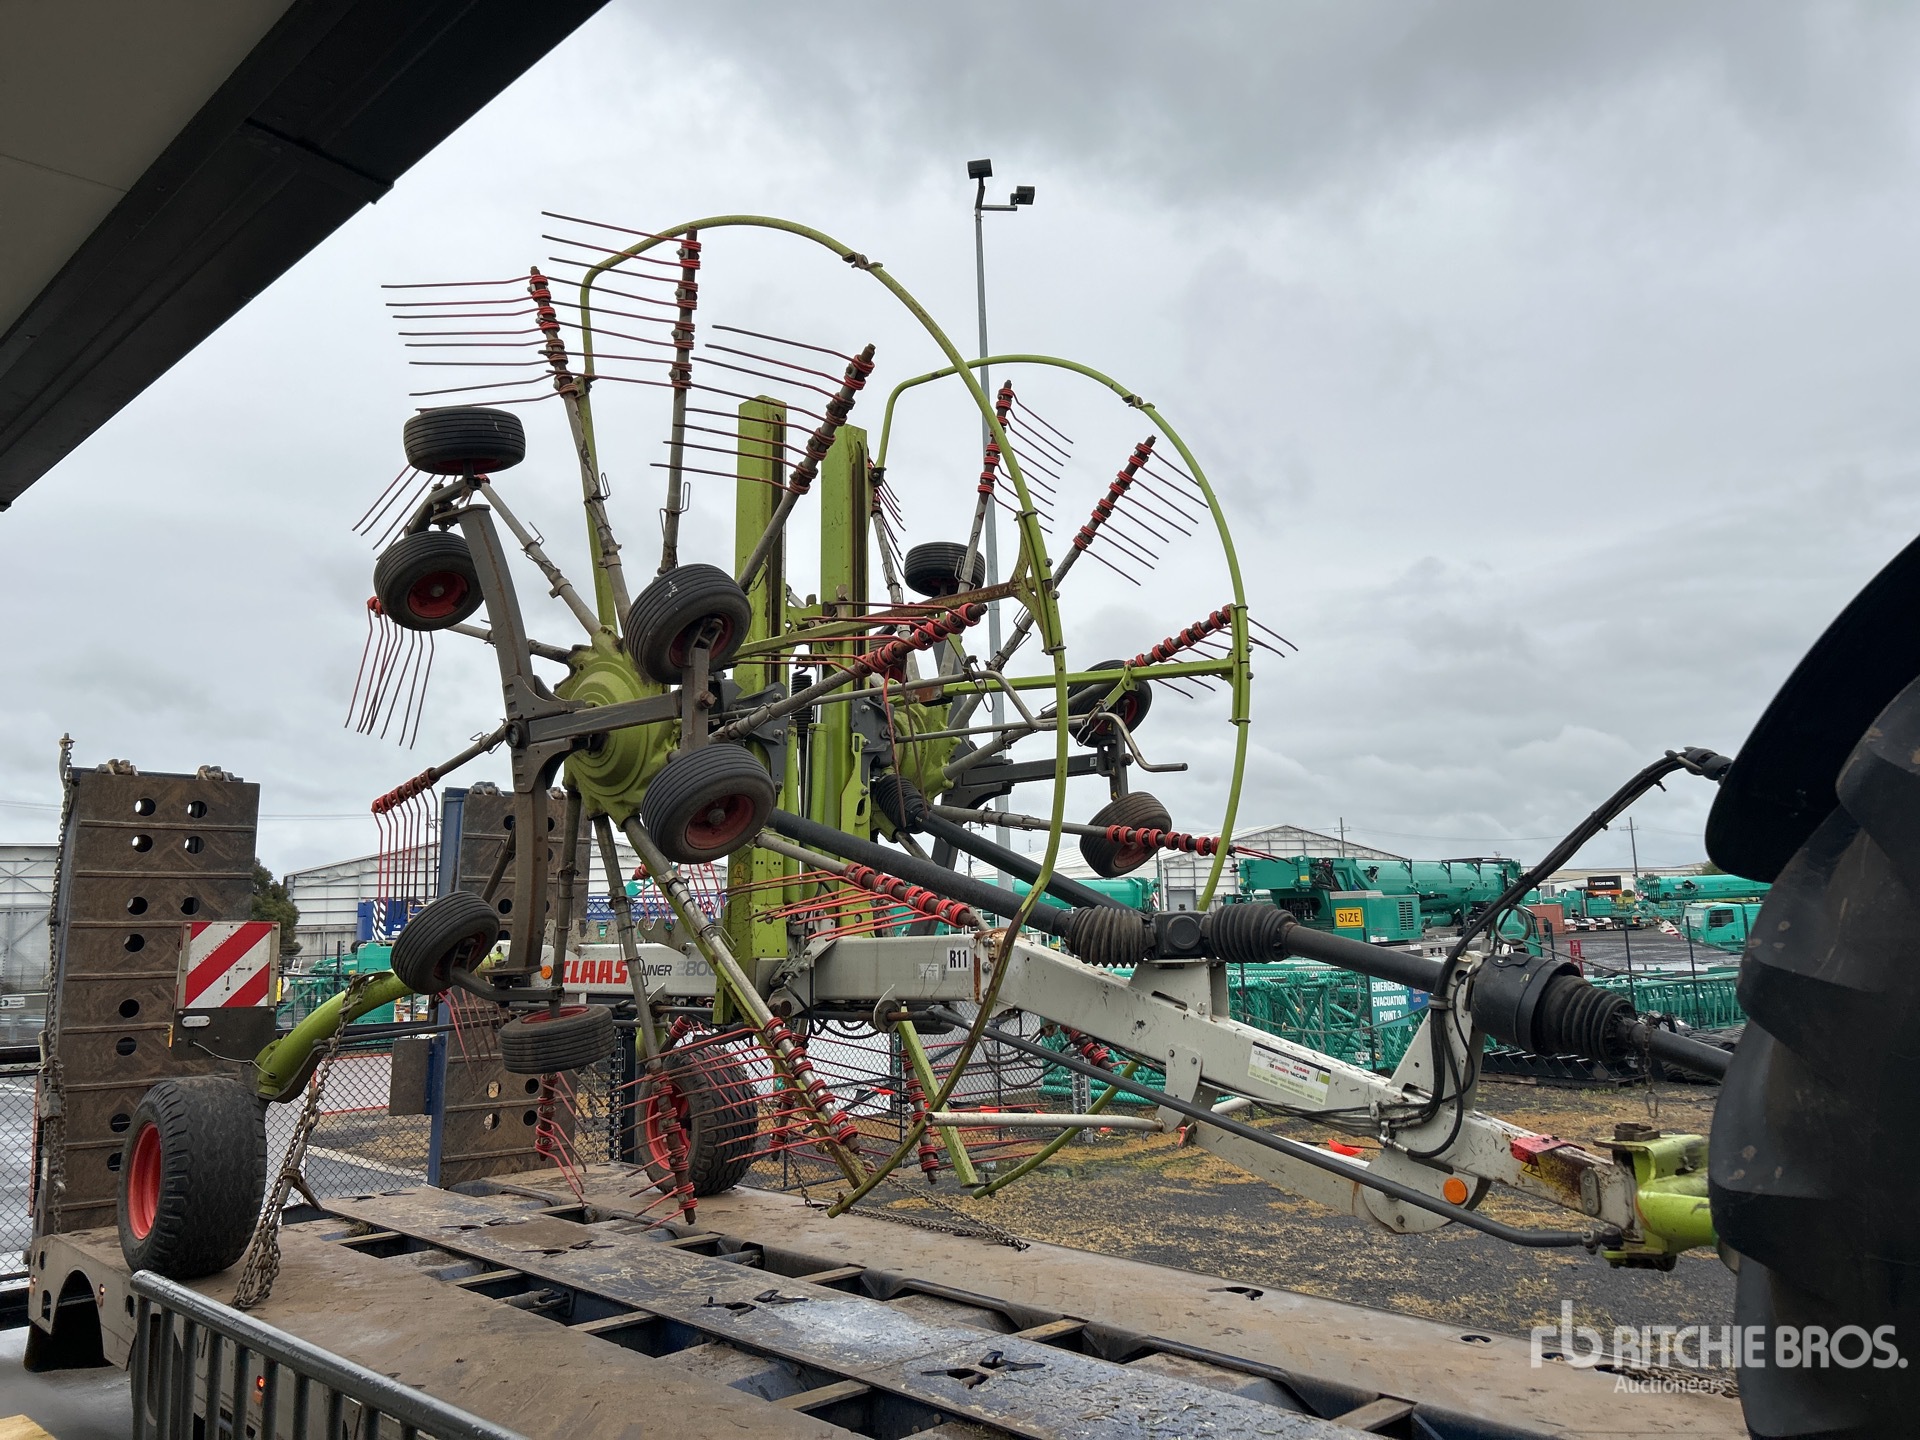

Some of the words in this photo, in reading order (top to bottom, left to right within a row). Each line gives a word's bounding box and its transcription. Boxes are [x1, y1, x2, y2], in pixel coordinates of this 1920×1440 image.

[1338, 912, 1360, 923] SIZE
[949, 949, 967, 968] R11
[563, 960, 628, 985] CLAAS
[1373, 995, 1407, 1007] EVACUATION
[1380, 1010, 1396, 1021] POINT
[1397, 1009, 1402, 1019] 3
